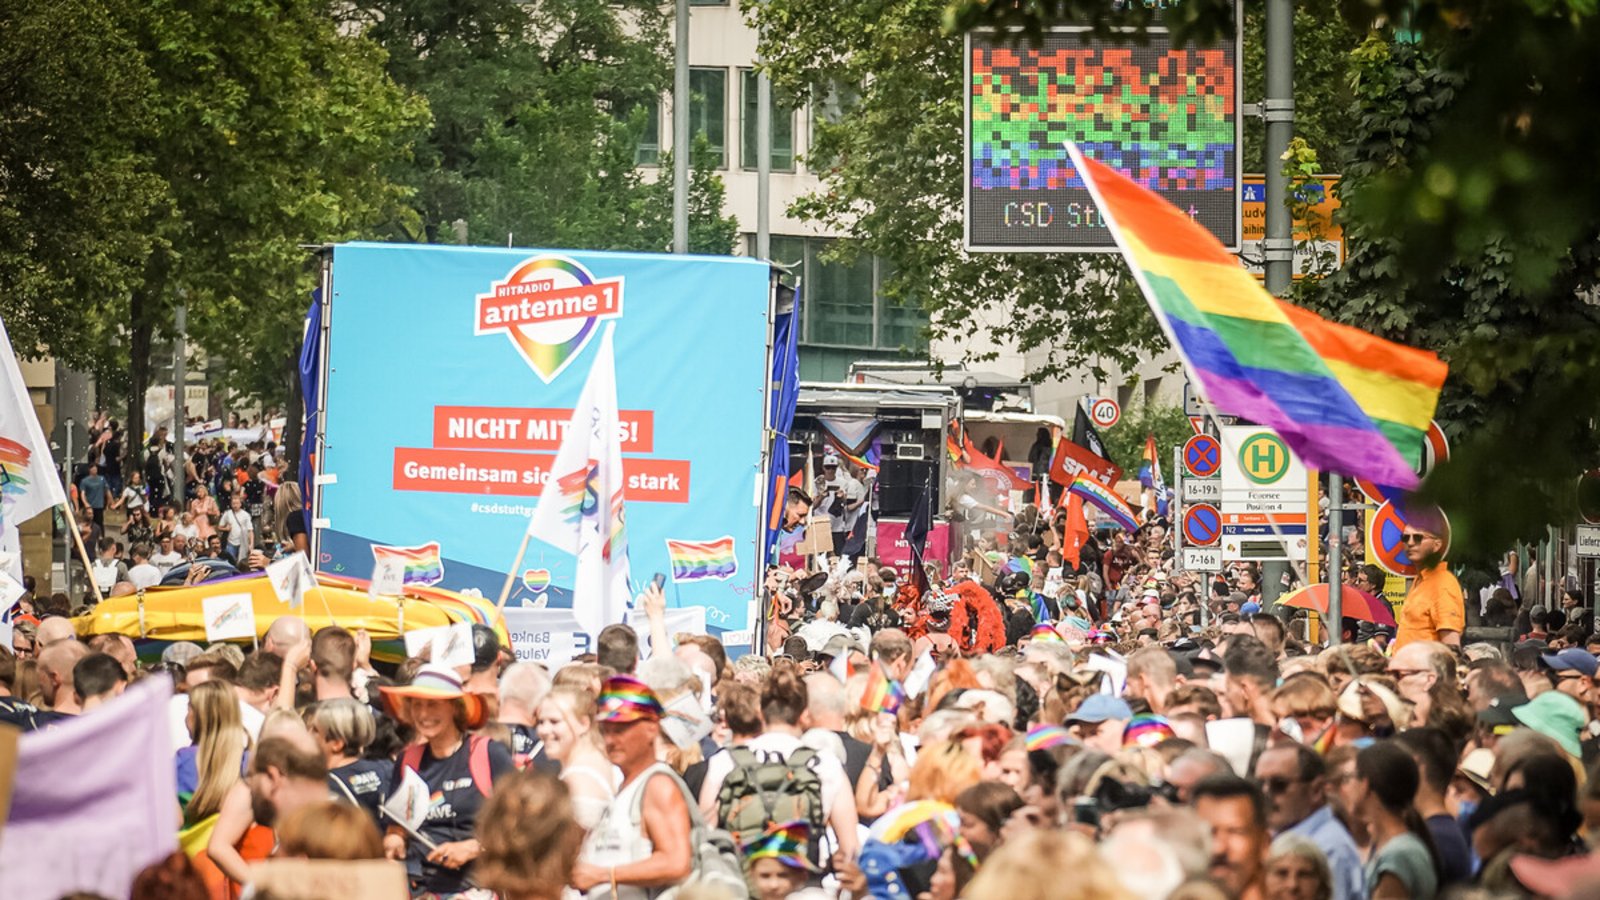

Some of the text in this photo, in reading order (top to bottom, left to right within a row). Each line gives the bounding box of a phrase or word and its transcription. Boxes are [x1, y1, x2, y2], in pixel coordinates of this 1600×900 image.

[1004, 202, 1053, 227] CSD
[498, 282, 551, 297] HITRADIO
[484, 287, 613, 324] antenne 1
[1097, 406, 1114, 419] 40
[448, 417, 521, 440] NICHT
[1252, 445, 1275, 472] H
[404, 461, 680, 491] Gemeinsam sic stark
[1190, 555, 1210, 565] 7-16
